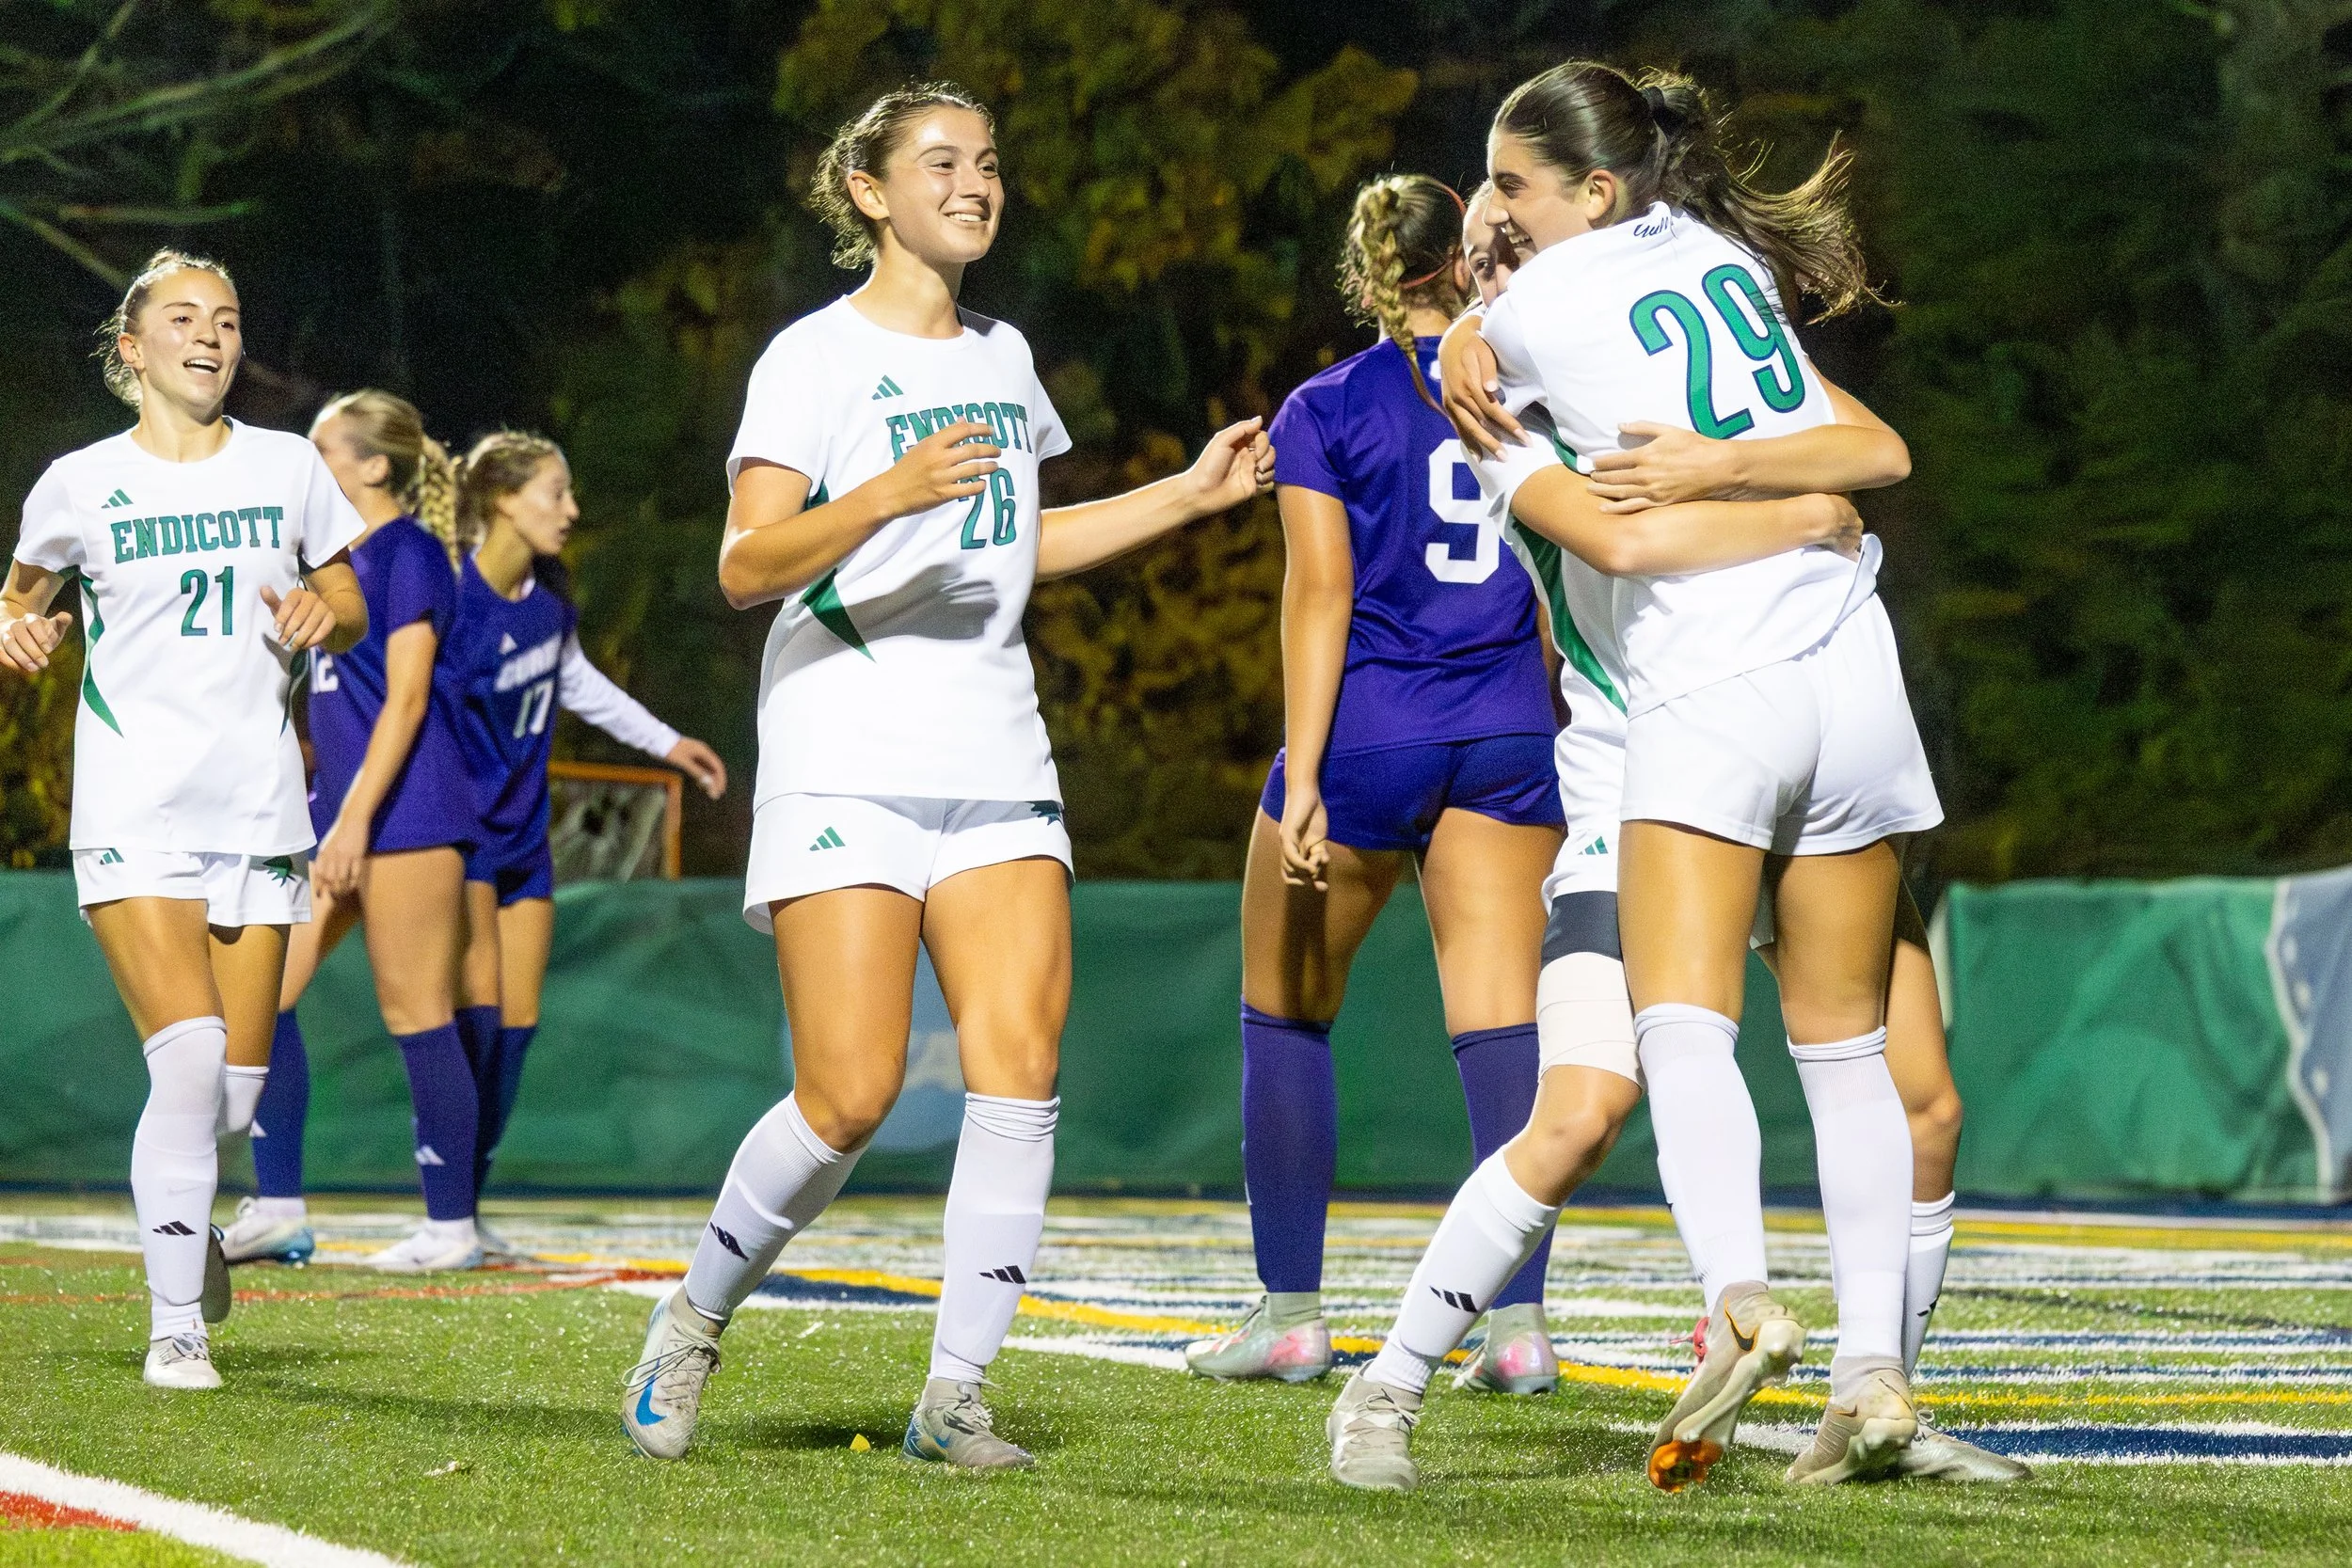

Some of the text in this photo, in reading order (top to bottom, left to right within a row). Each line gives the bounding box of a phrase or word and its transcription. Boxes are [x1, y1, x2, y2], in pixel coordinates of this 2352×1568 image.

[1629, 263, 1805, 440] 29
[110, 506, 284, 564] ENDICOTT
[958, 467, 1017, 550] 26
[181, 565, 233, 637] 21
[513, 679, 554, 738] 17
